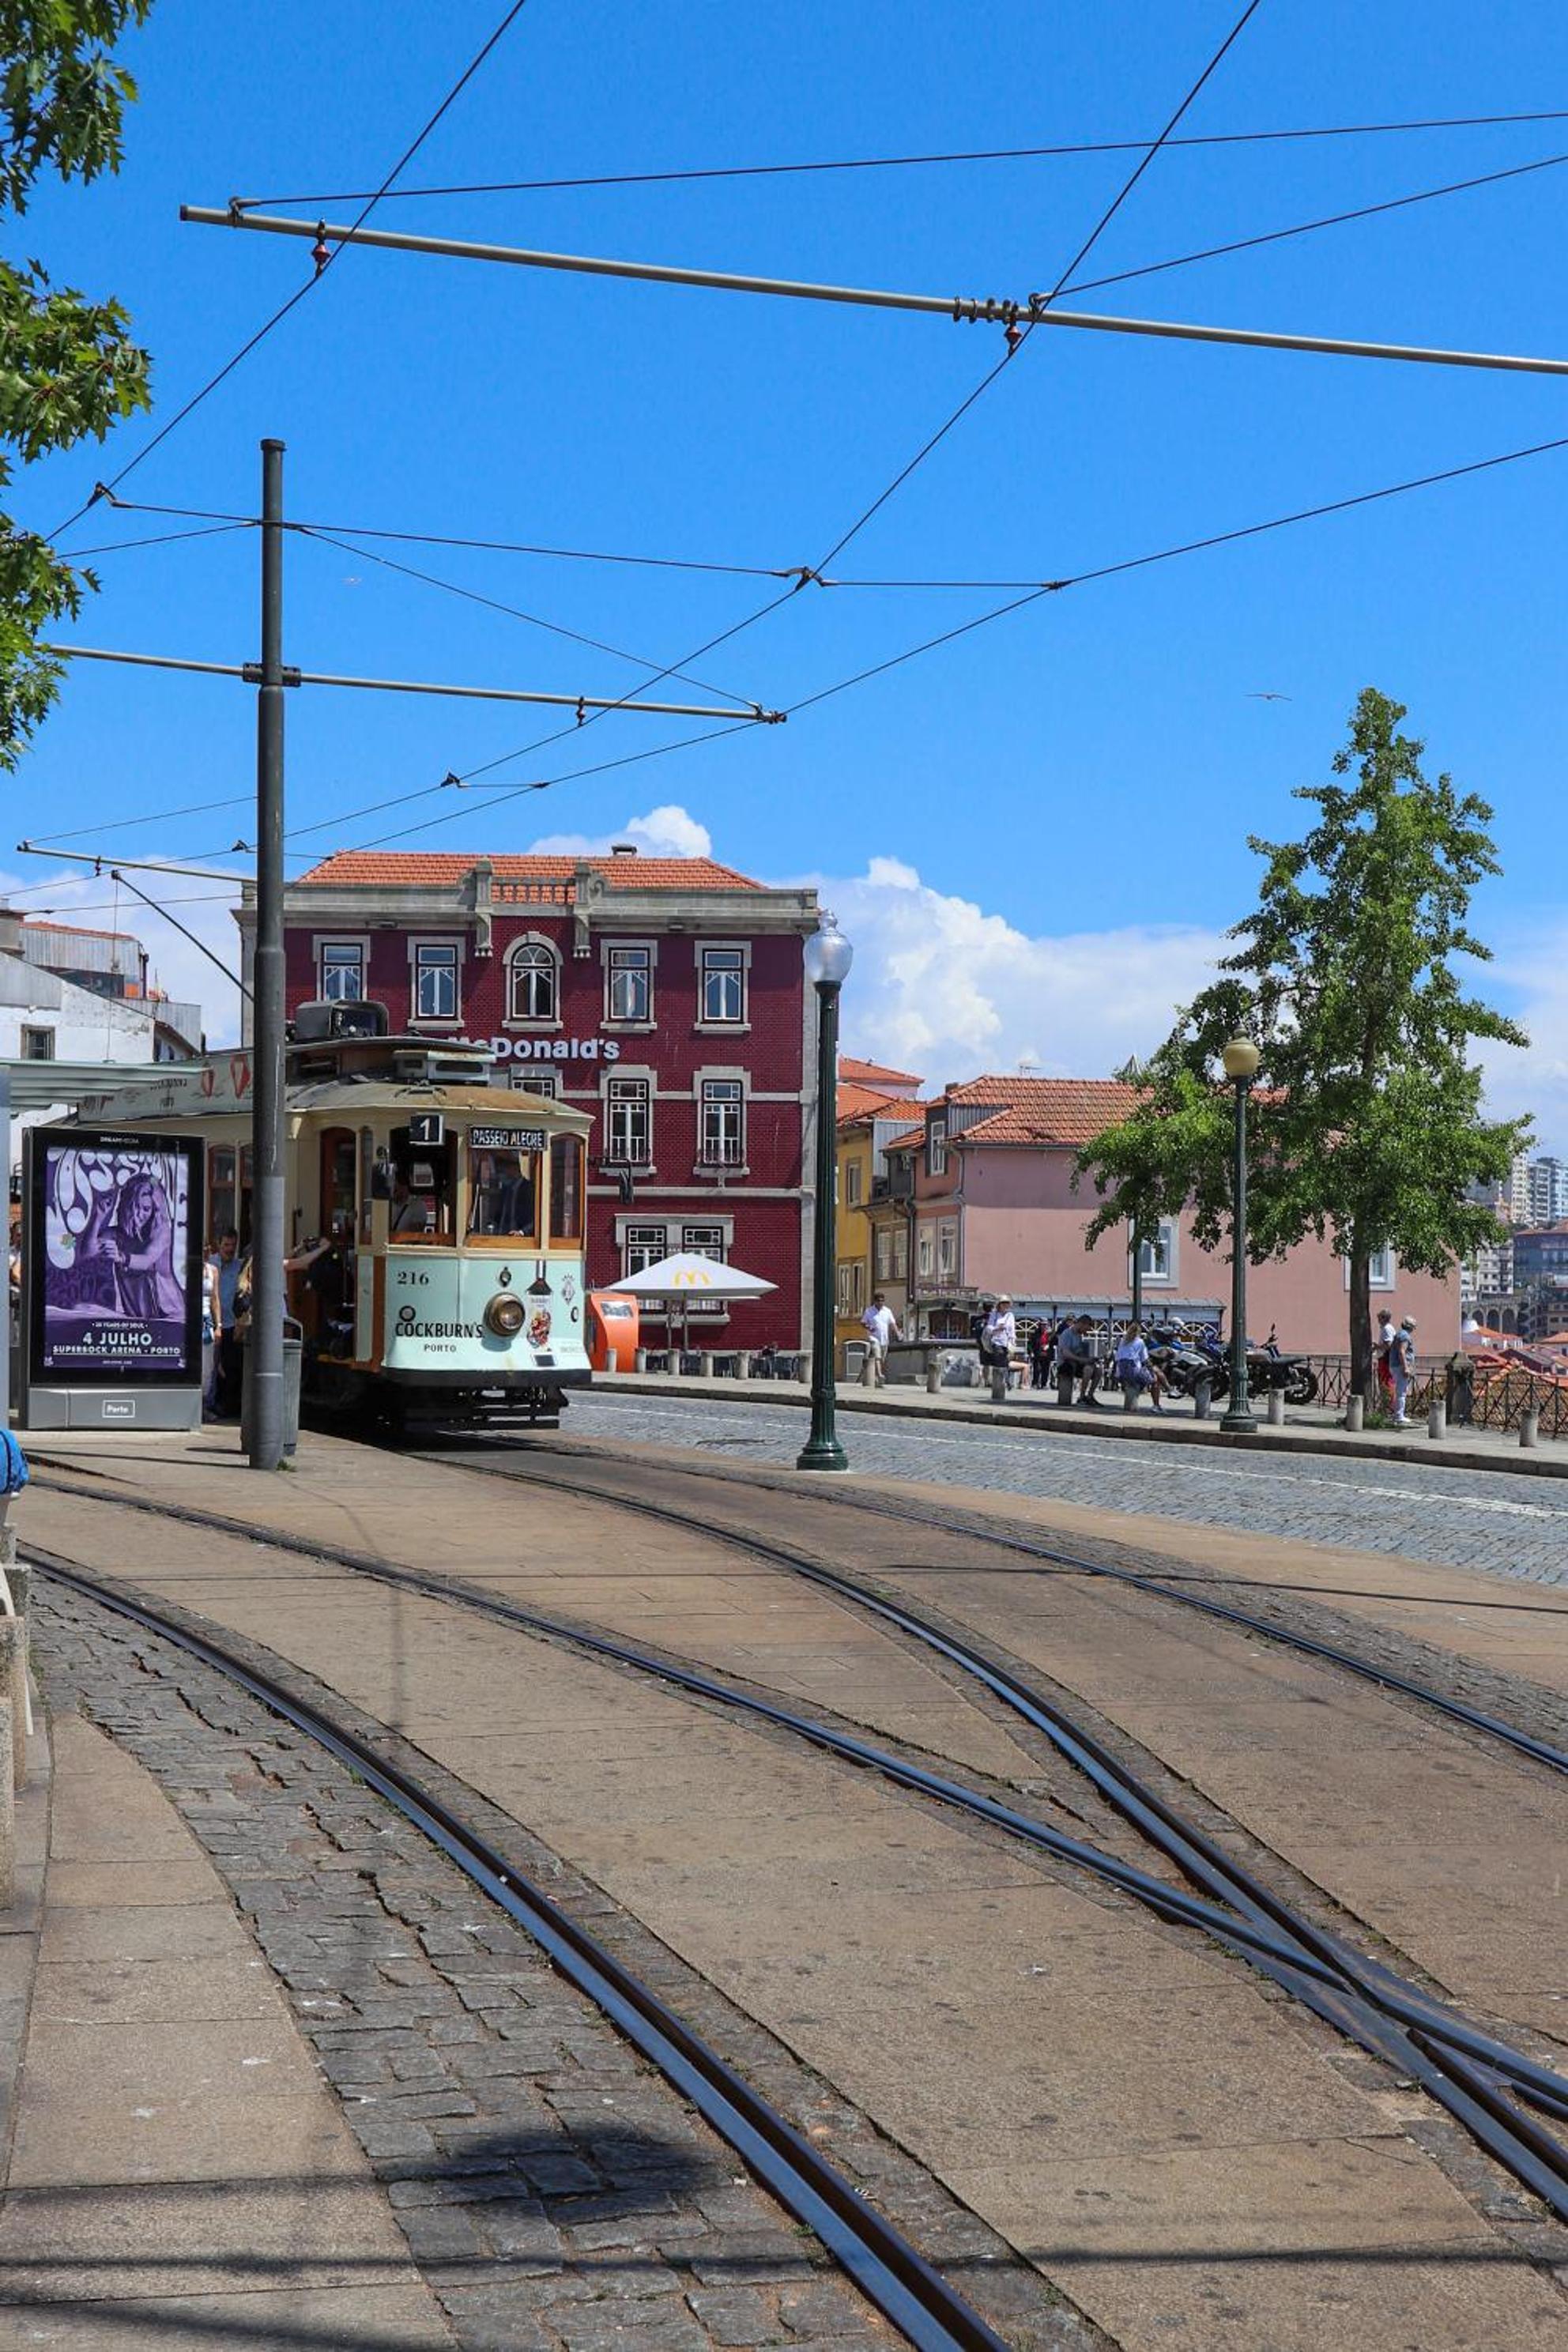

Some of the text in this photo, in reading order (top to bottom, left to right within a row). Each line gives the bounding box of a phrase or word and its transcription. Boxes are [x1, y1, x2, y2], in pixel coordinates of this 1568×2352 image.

[448, 1037, 620, 1059] Donald's
[420, 1118, 431, 1140] 1
[473, 1129, 543, 1146] PASSEIO ALEGRE
[397, 1271, 429, 1285] 216
[83, 1332, 152, 1345] 4 JULHO
[395, 1321, 485, 1339] COCKBURN'S
[424, 1344, 457, 1352] PORTO
